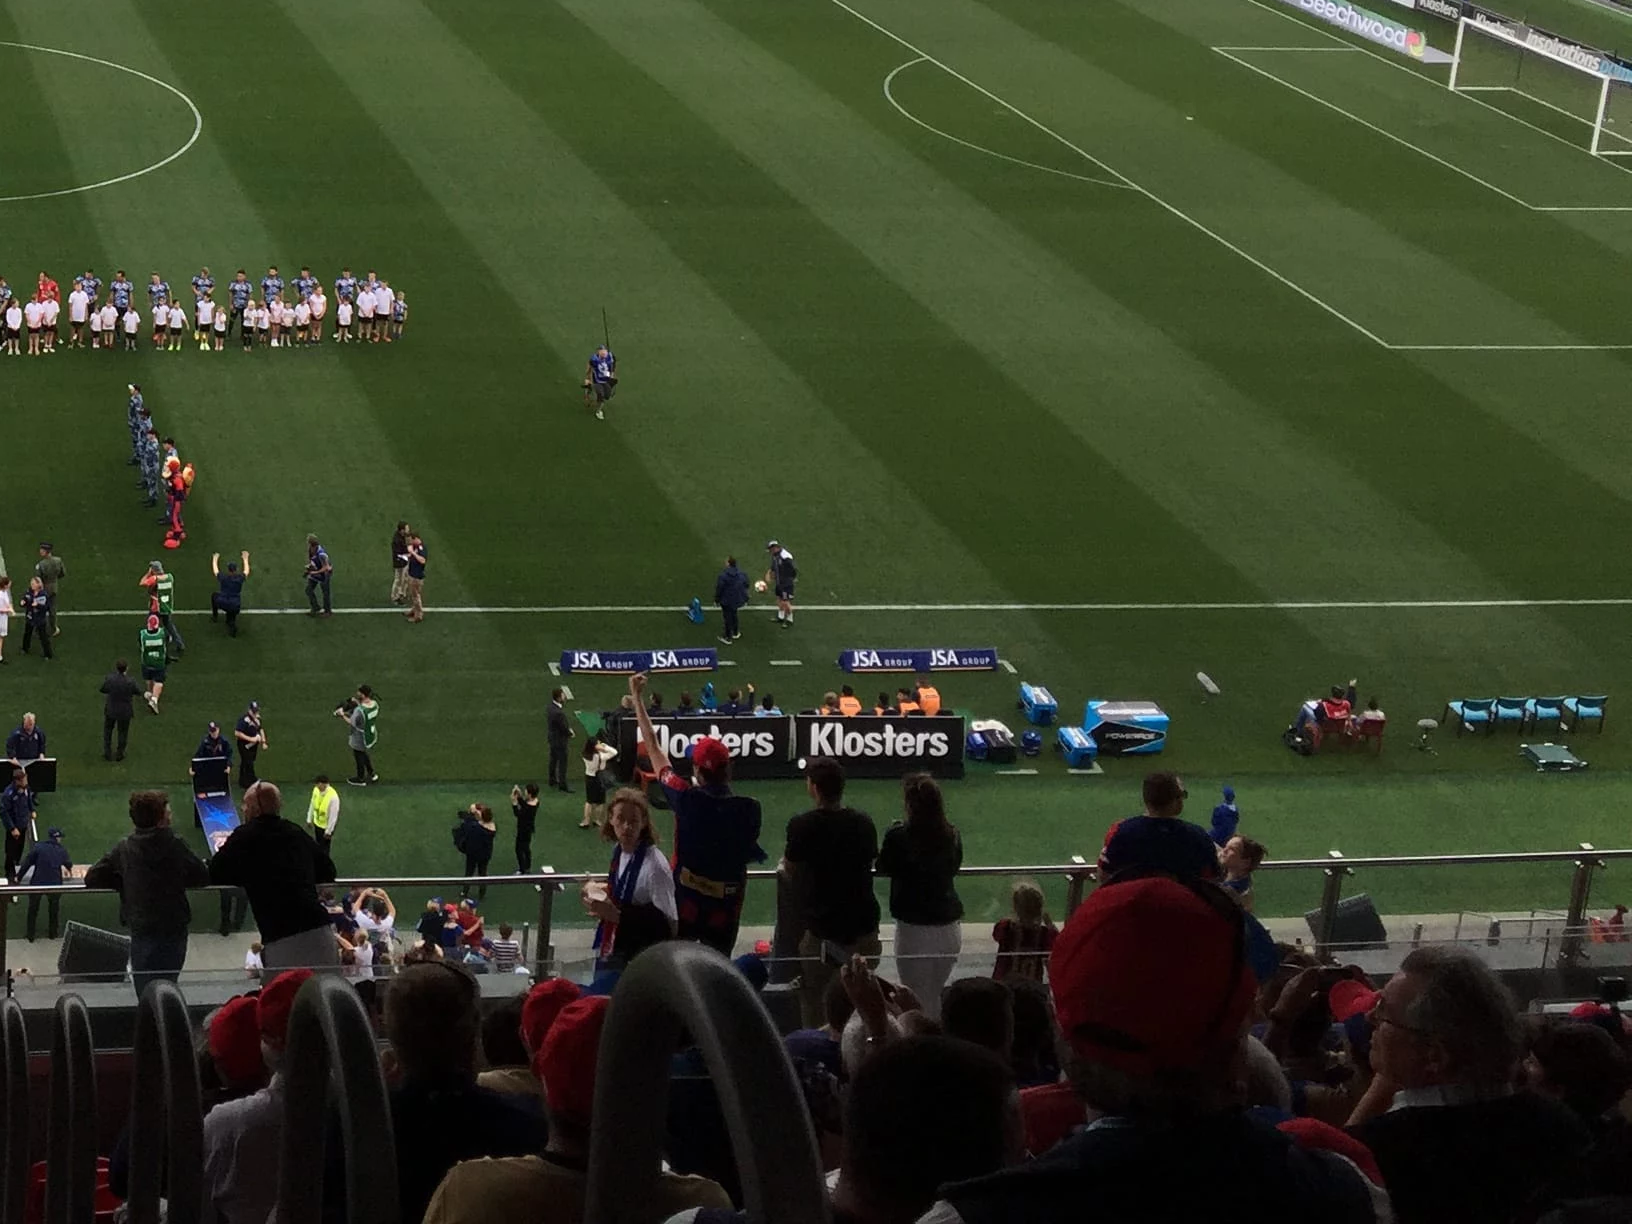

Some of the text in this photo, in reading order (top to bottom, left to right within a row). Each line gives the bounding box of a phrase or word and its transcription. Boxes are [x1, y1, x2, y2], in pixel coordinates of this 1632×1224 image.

[571, 651, 634, 669] JSA GROUP
[650, 651, 710, 668] JSA GROUP
[852, 651, 882, 667] JSA
[930, 649, 990, 666] JSA GROUP
[810, 722, 949, 757] Klosters
